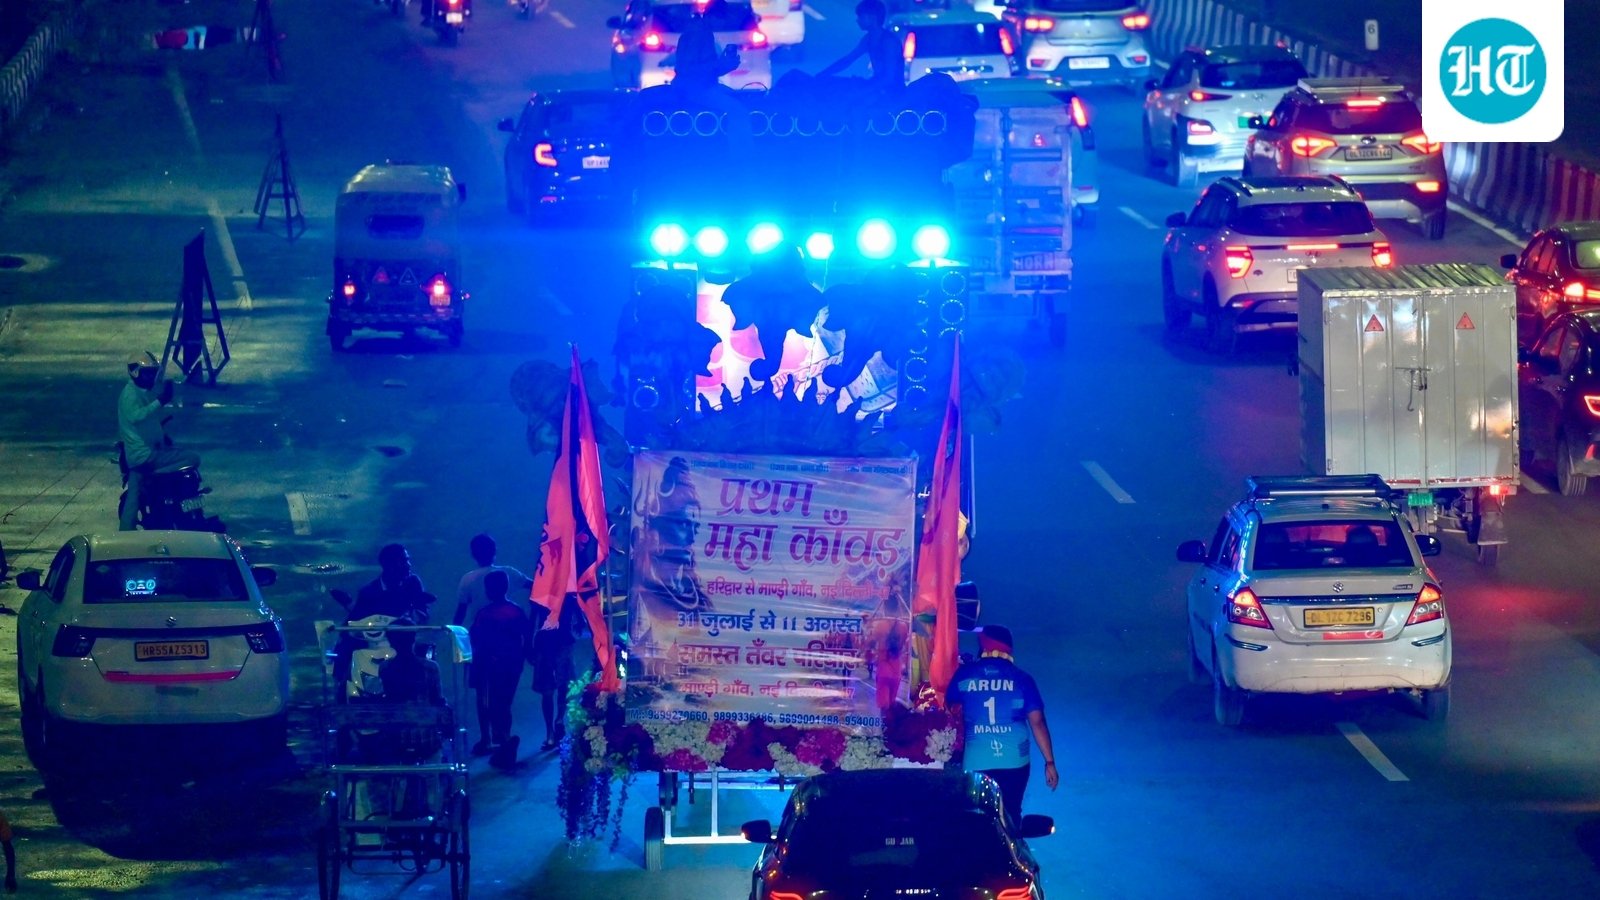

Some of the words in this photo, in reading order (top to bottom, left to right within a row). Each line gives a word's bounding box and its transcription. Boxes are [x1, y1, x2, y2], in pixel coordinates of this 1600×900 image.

[1368, 23, 1376, 35] 6
[717, 477, 818, 518] प्रथम
[704, 522, 779, 571] महा
[707, 576, 743, 596] हरिद्वार
[745, 577, 756, 595] से
[678, 611, 695, 628] 31
[699, 608, 756, 637] जुलाई
[759, 609, 777, 630] से
[678, 643, 741, 665] समस्त
[967, 679, 1014, 692] ARUN
[983, 696, 996, 725] 1
